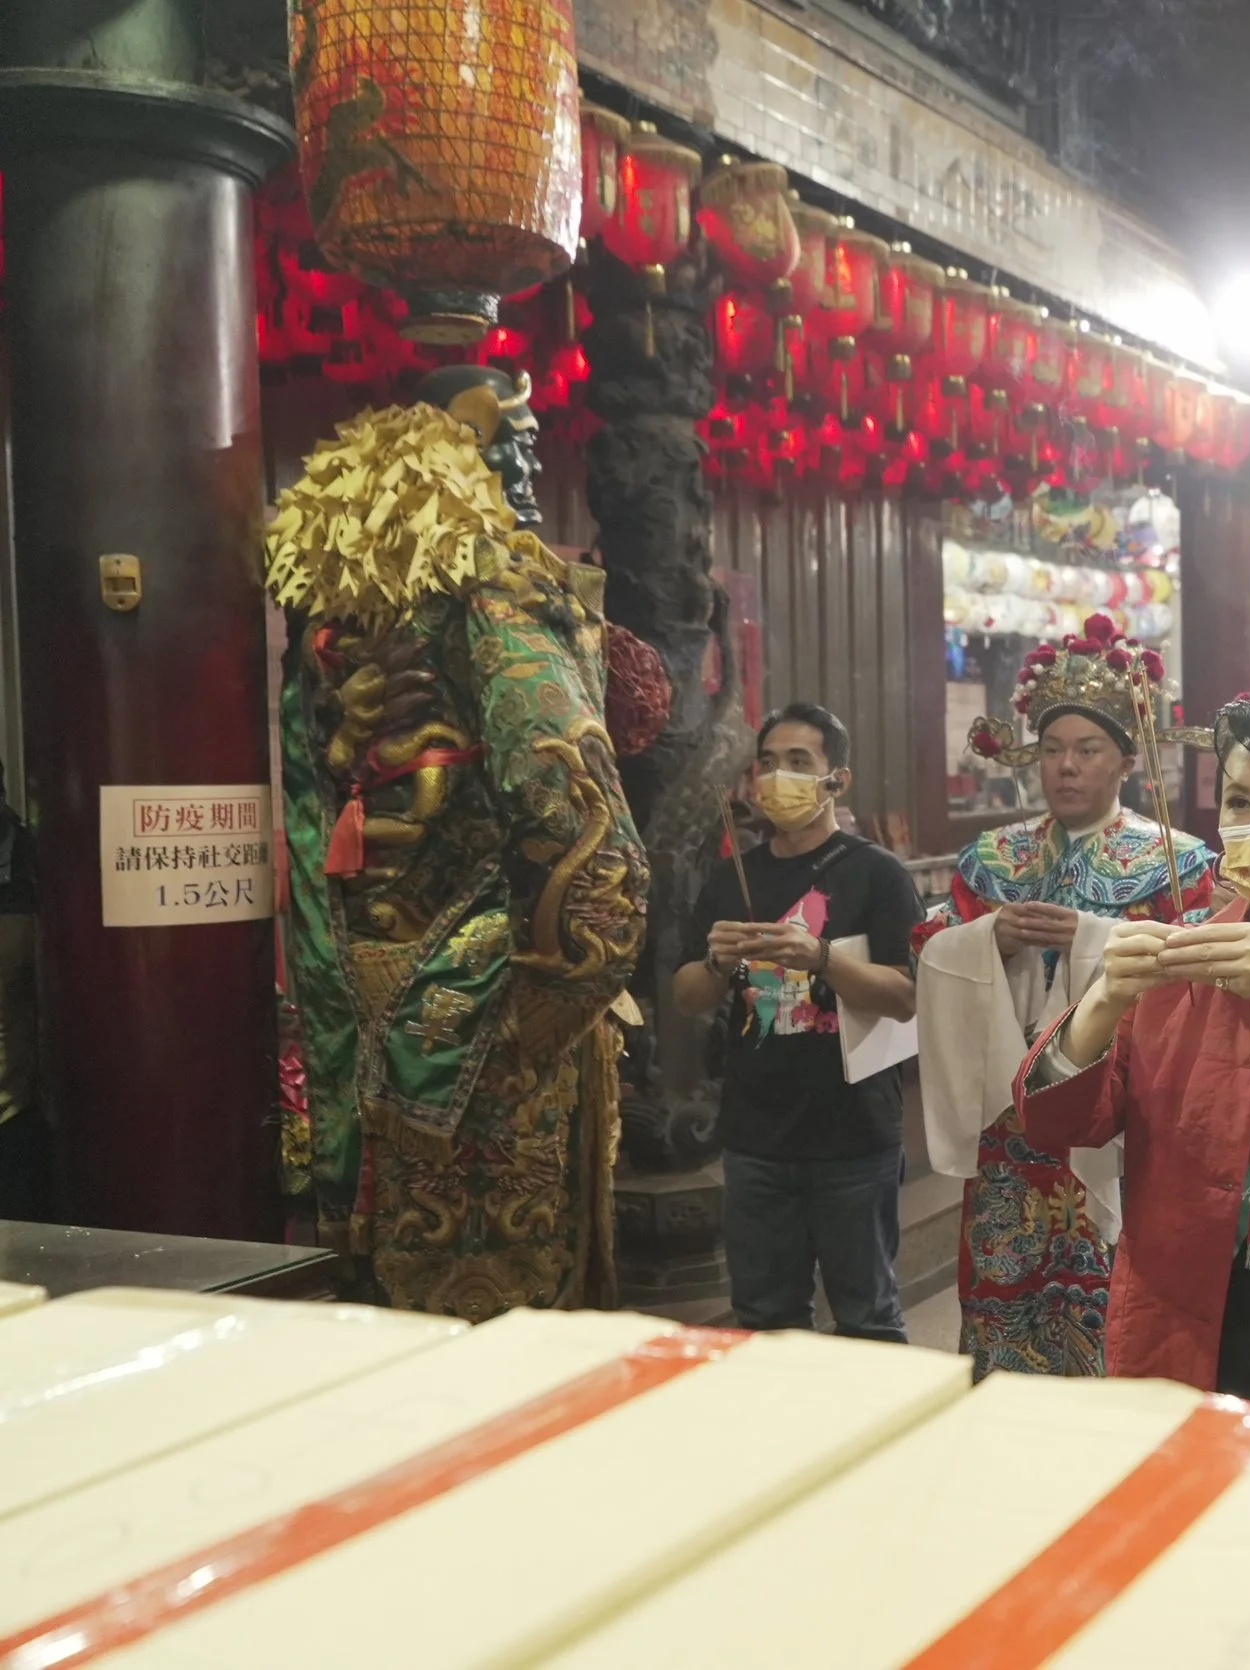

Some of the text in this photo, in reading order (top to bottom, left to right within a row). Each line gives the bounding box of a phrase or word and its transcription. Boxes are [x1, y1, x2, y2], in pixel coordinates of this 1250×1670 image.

[140, 802, 258, 833] 防疫期間
[156, 878, 254, 909] 1.5公尺
